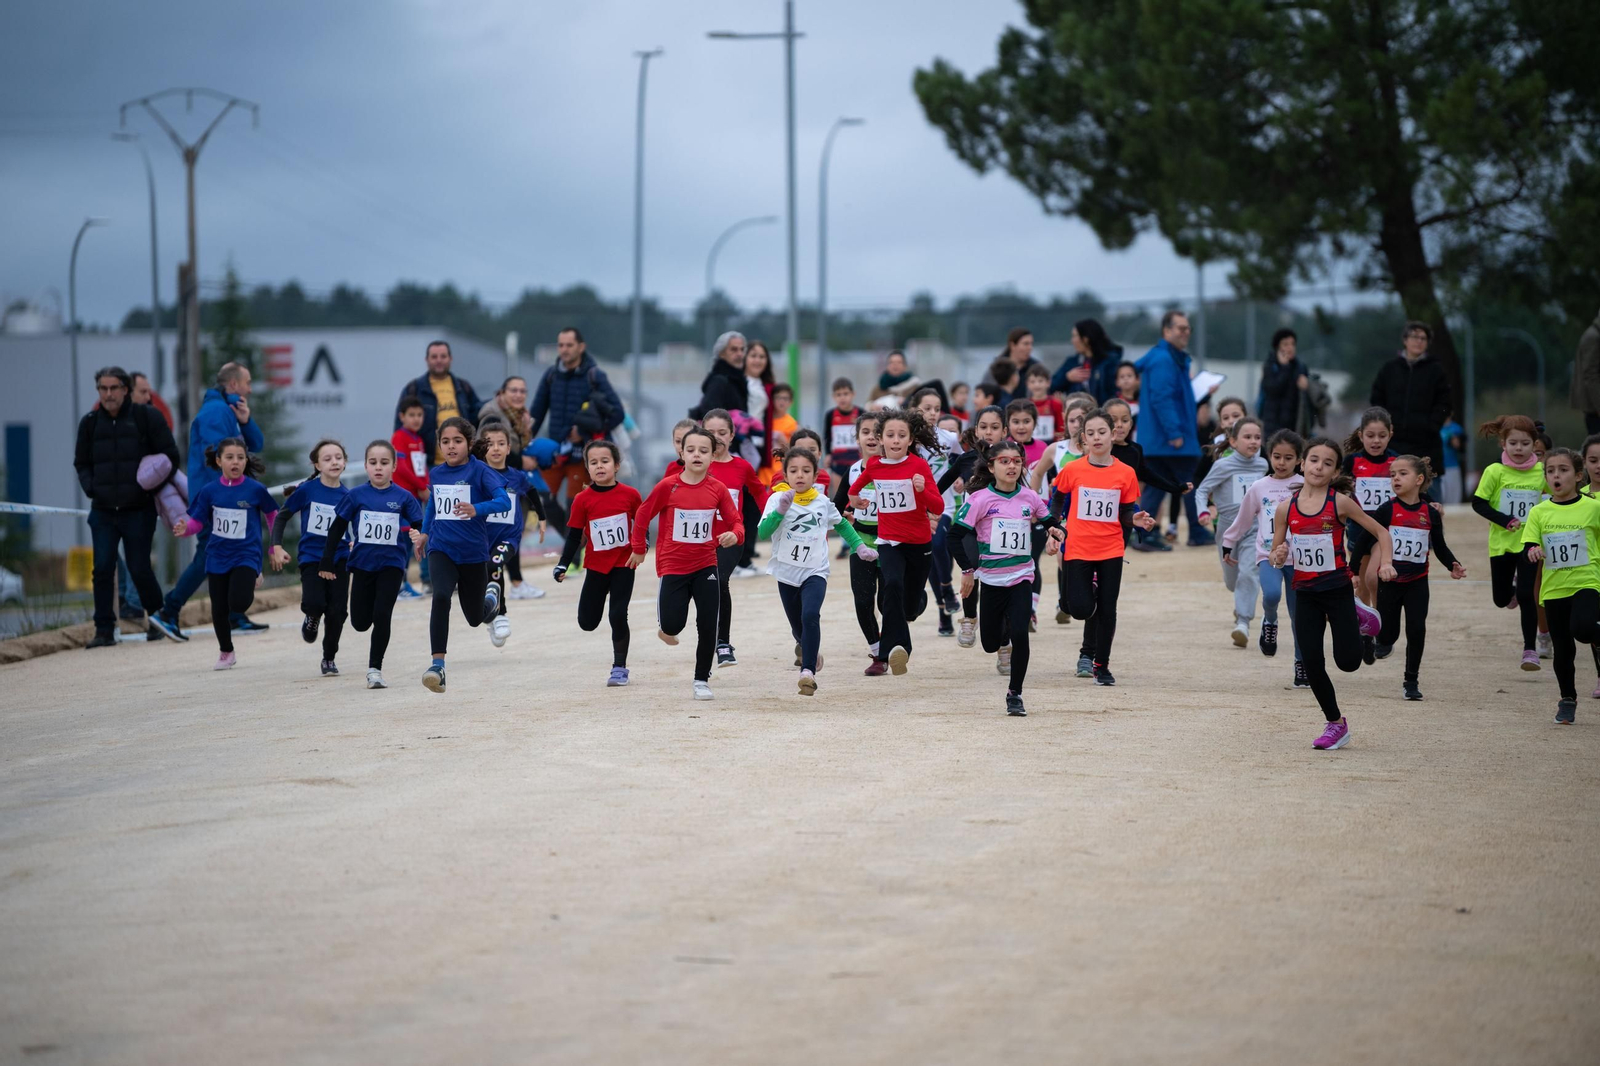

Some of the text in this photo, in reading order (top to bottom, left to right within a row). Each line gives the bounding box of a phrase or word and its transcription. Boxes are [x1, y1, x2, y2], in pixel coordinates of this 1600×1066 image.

[880, 491, 906, 509] 152
[1364, 488, 1391, 505] 255
[1086, 500, 1114, 518] 136
[216, 518, 239, 535] 207
[315, 514, 332, 532] 21
[364, 522, 392, 541] 208
[682, 522, 709, 538] 149
[598, 526, 626, 546] 150
[1000, 531, 1026, 550] 131
[790, 544, 811, 562] 47
[1296, 548, 1324, 566] 256
[1394, 538, 1422, 558] 252
[1550, 544, 1579, 563] 187
